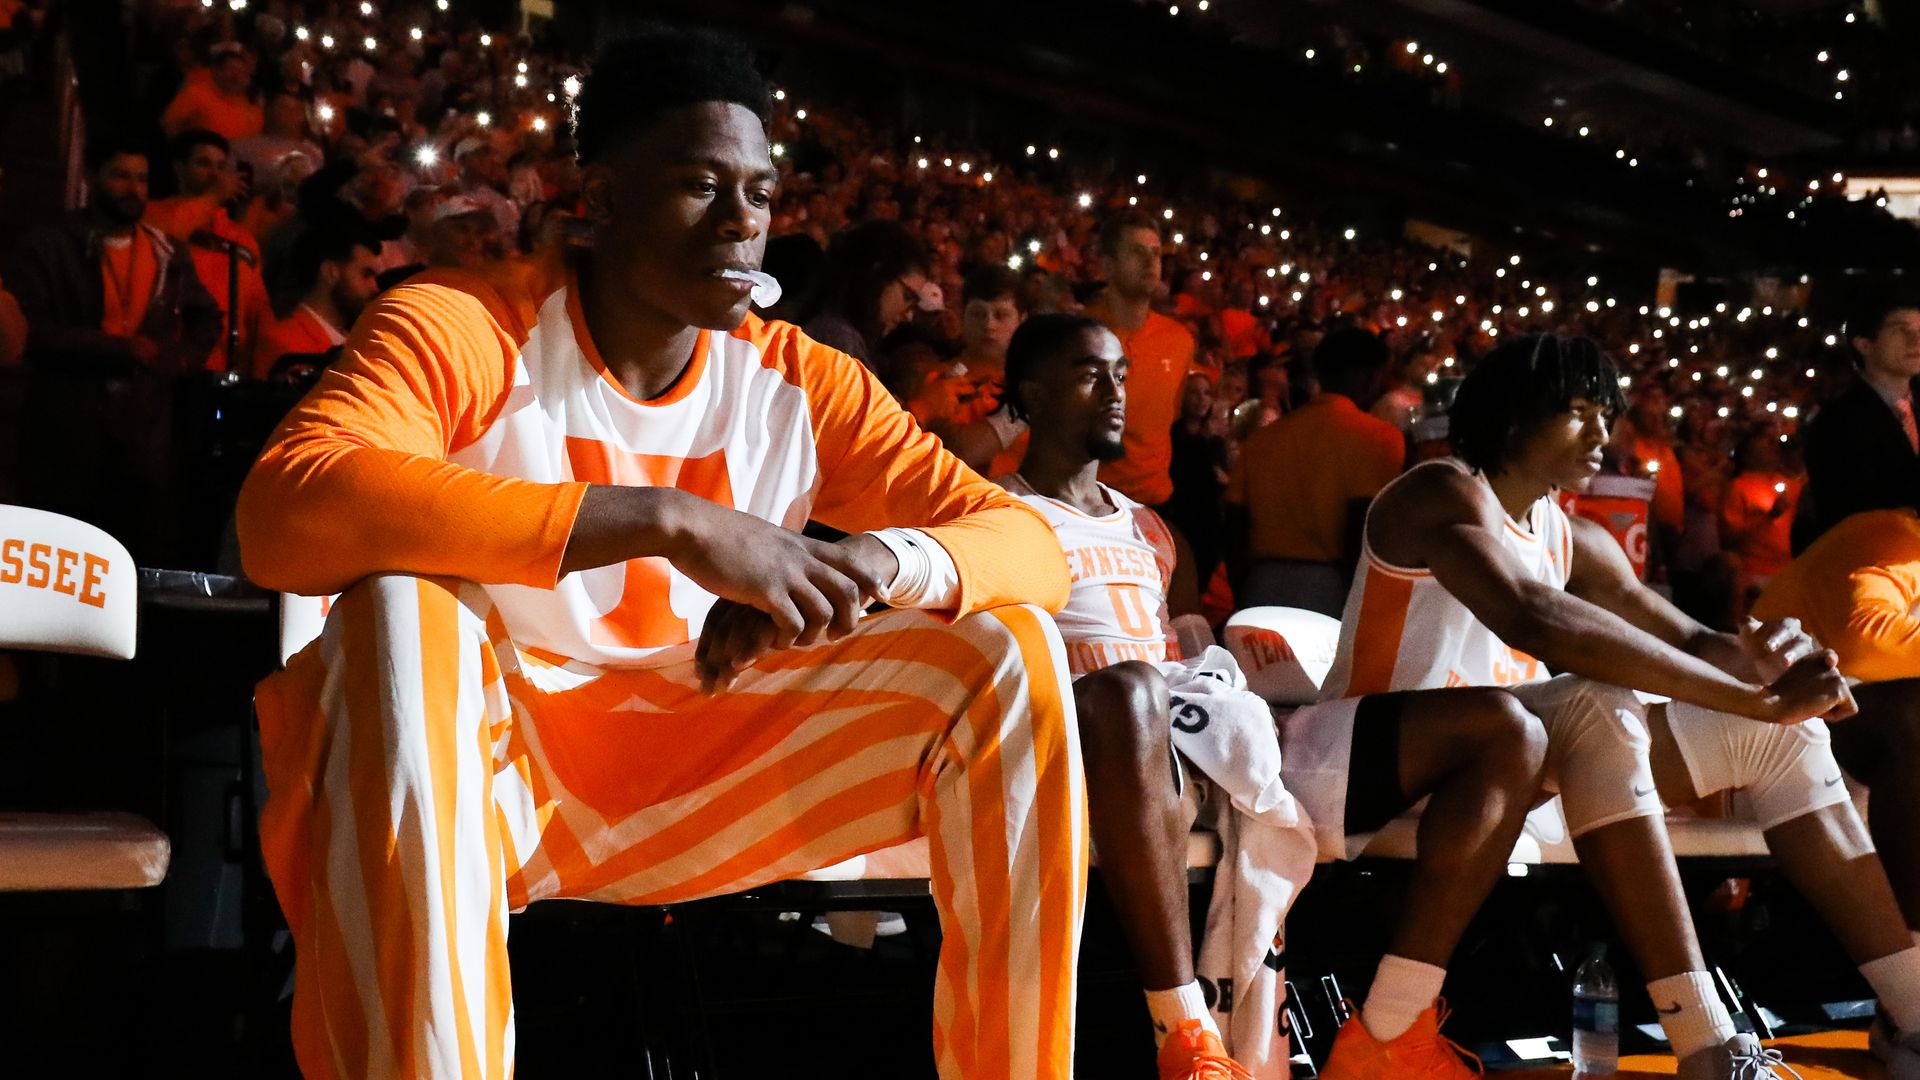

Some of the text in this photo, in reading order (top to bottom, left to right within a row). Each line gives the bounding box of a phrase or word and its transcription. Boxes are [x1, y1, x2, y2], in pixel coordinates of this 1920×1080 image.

[1064, 546, 1160, 584] ENNESS
[1624, 523, 1648, 564] G
[0, 538, 110, 609] SSEE
[1104, 582, 1155, 638] 0
